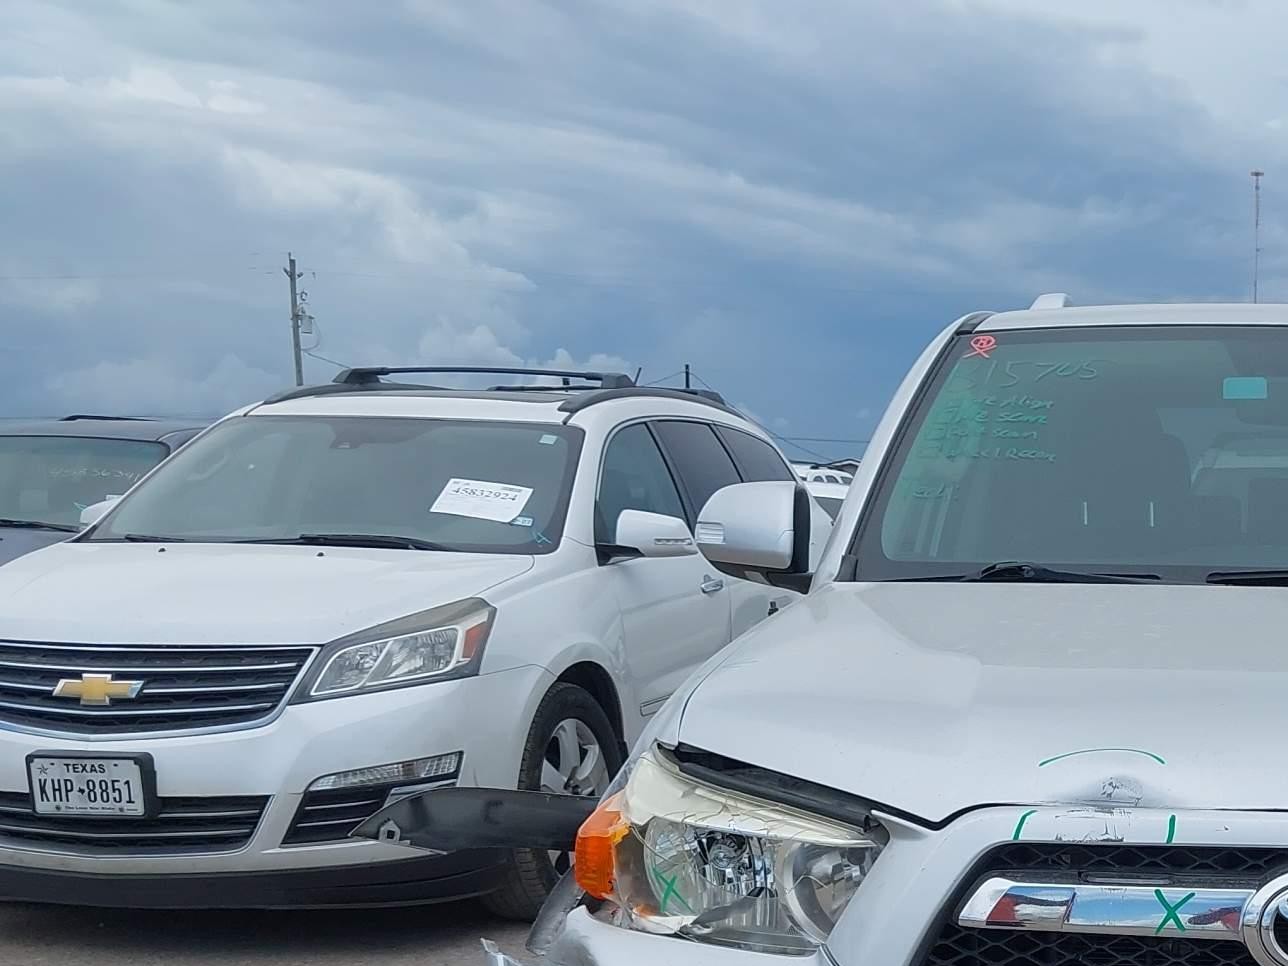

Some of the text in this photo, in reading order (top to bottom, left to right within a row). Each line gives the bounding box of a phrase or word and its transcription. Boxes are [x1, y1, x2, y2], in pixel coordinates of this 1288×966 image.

[451, 486, 518, 502] 45832924
[63, 763, 106, 774] TEXAS
[38, 778, 136, 804] KHP 8851
